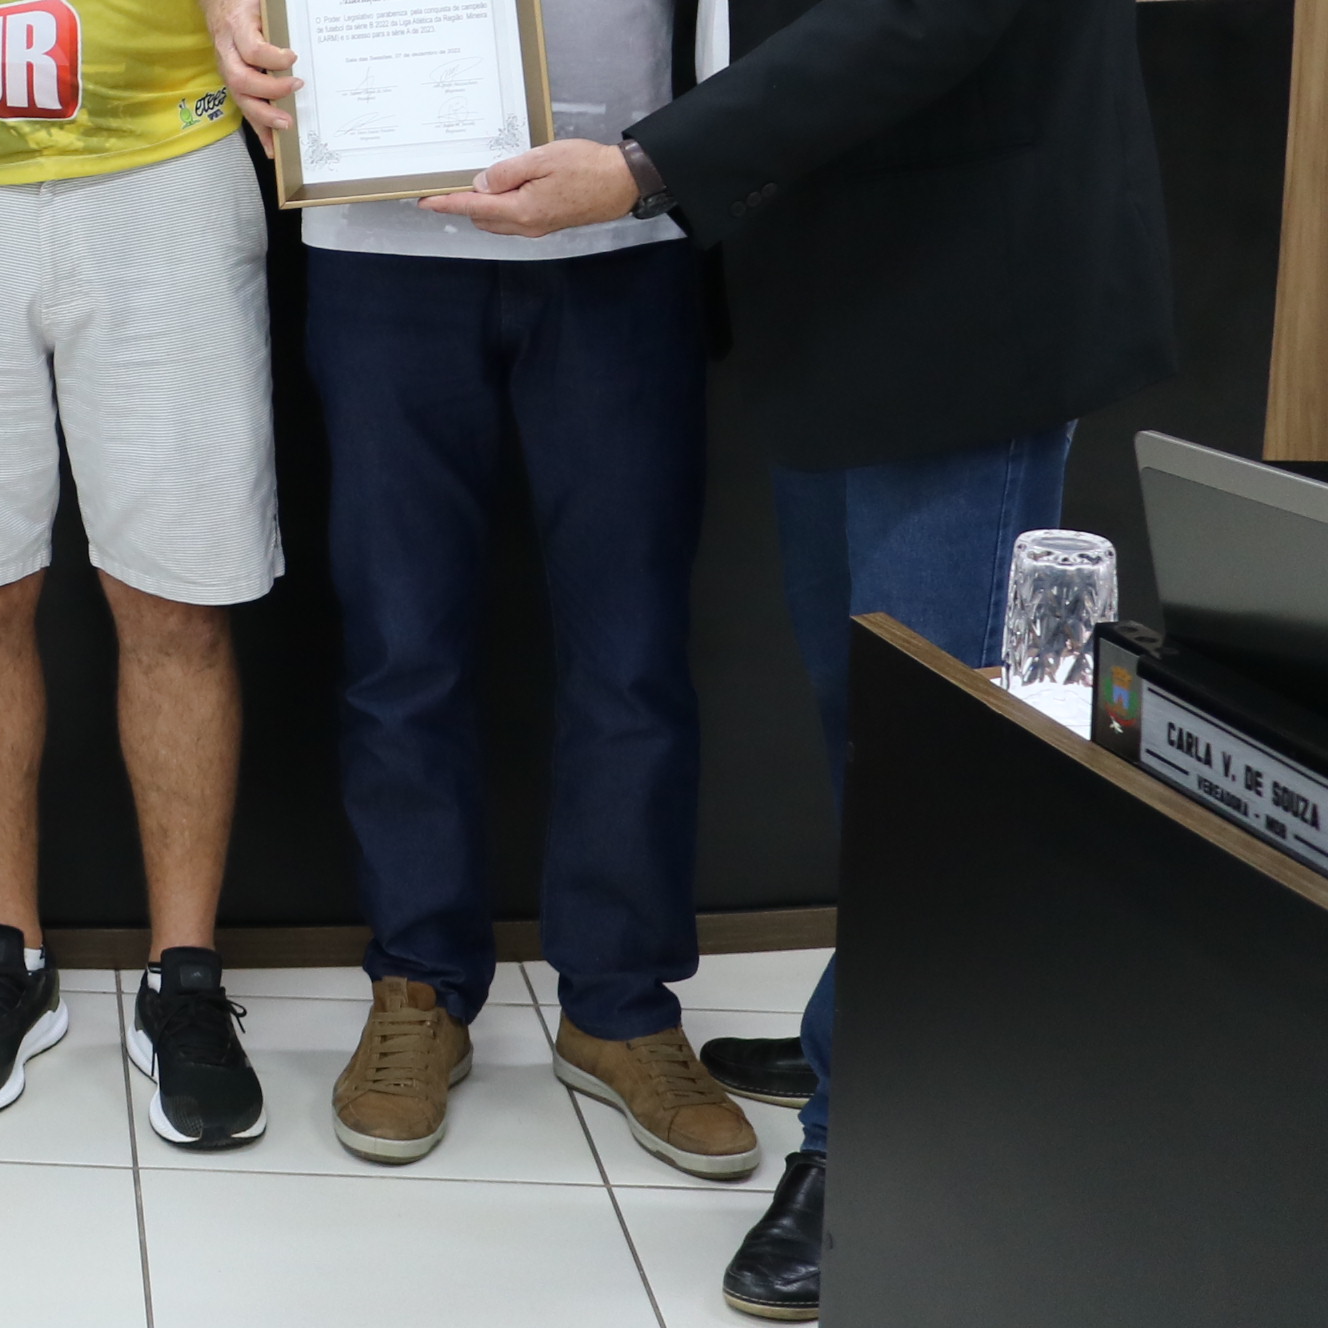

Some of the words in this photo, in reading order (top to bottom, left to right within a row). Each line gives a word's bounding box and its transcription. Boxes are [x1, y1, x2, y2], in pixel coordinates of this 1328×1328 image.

[1167, 723, 1213, 768] CARLA
[1222, 752, 1236, 781] V.
[1245, 764, 1263, 796] DE
[1272, 781, 1320, 830] SOUZA
[1197, 775, 1249, 818] VEREADORA
